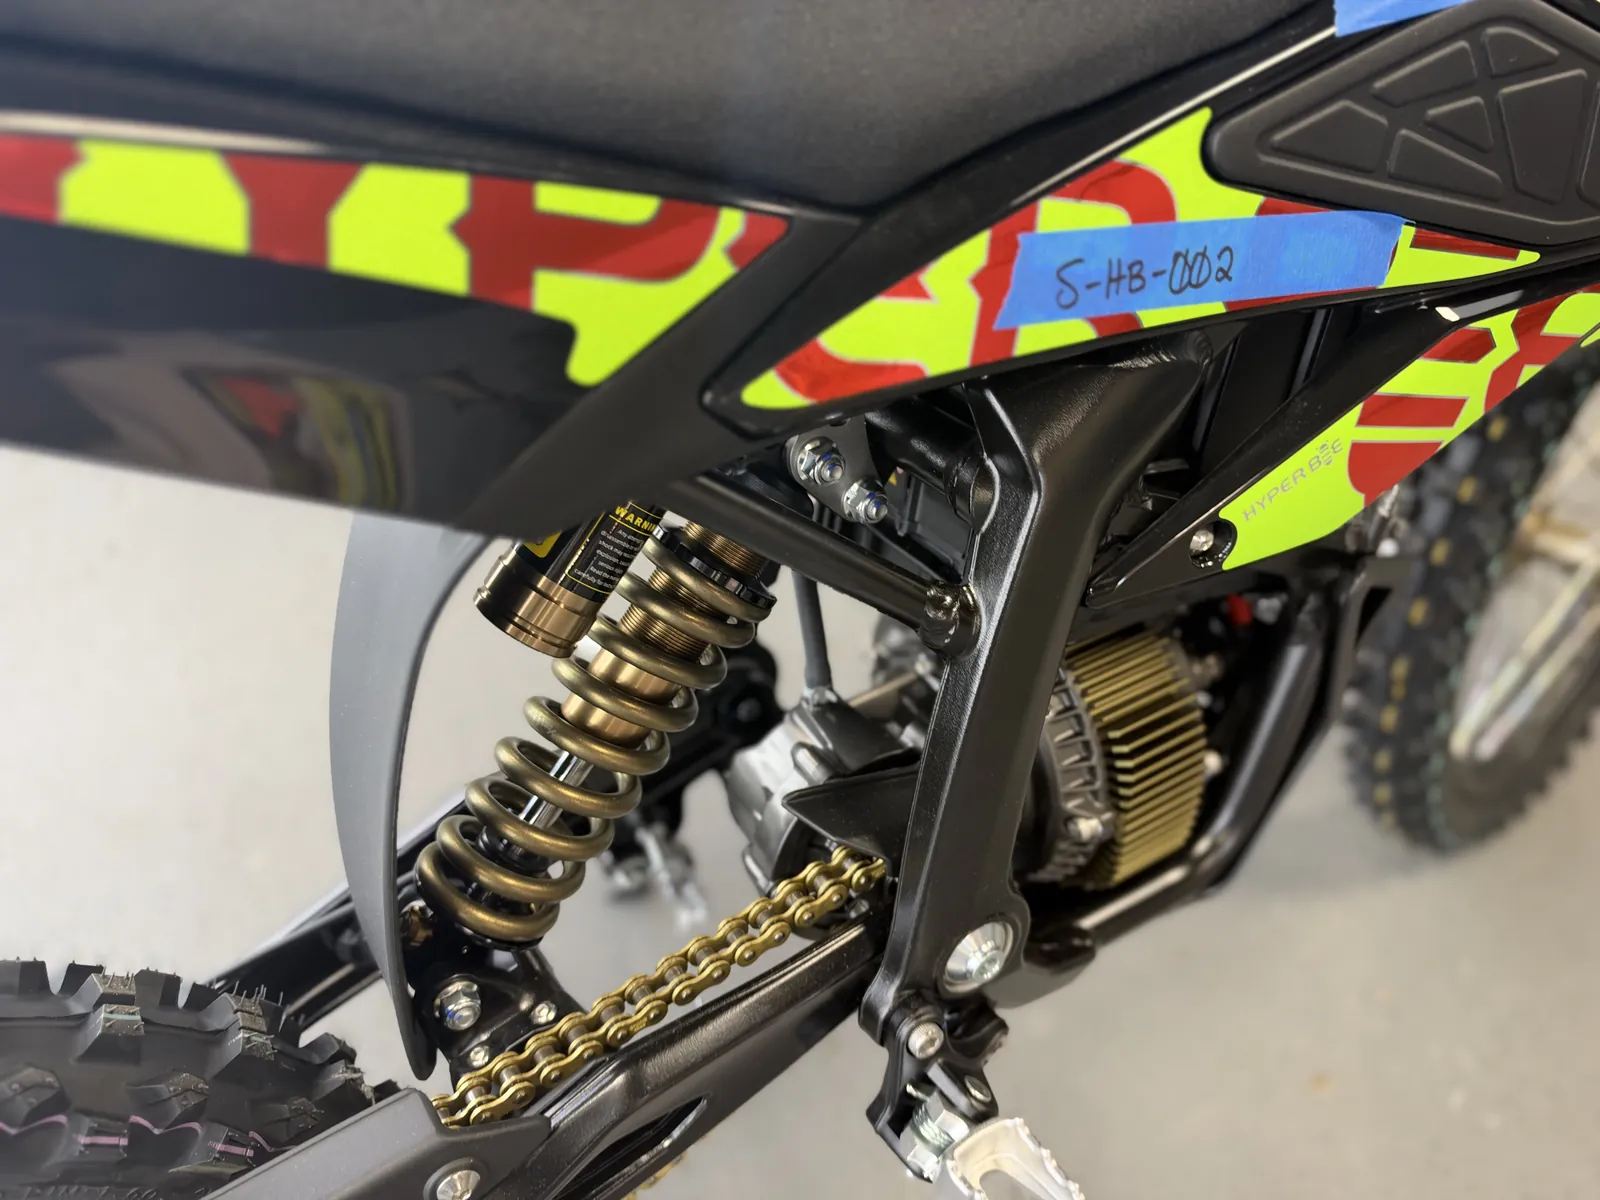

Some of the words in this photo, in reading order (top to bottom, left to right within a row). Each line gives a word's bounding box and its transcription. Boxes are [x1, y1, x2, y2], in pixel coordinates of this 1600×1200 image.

[1056, 245, 1234, 310] S-HB-002
[1242, 467, 1307, 521] HYPER
[1308, 438, 1343, 472] BEE
[598, 540, 613, 550] shock
